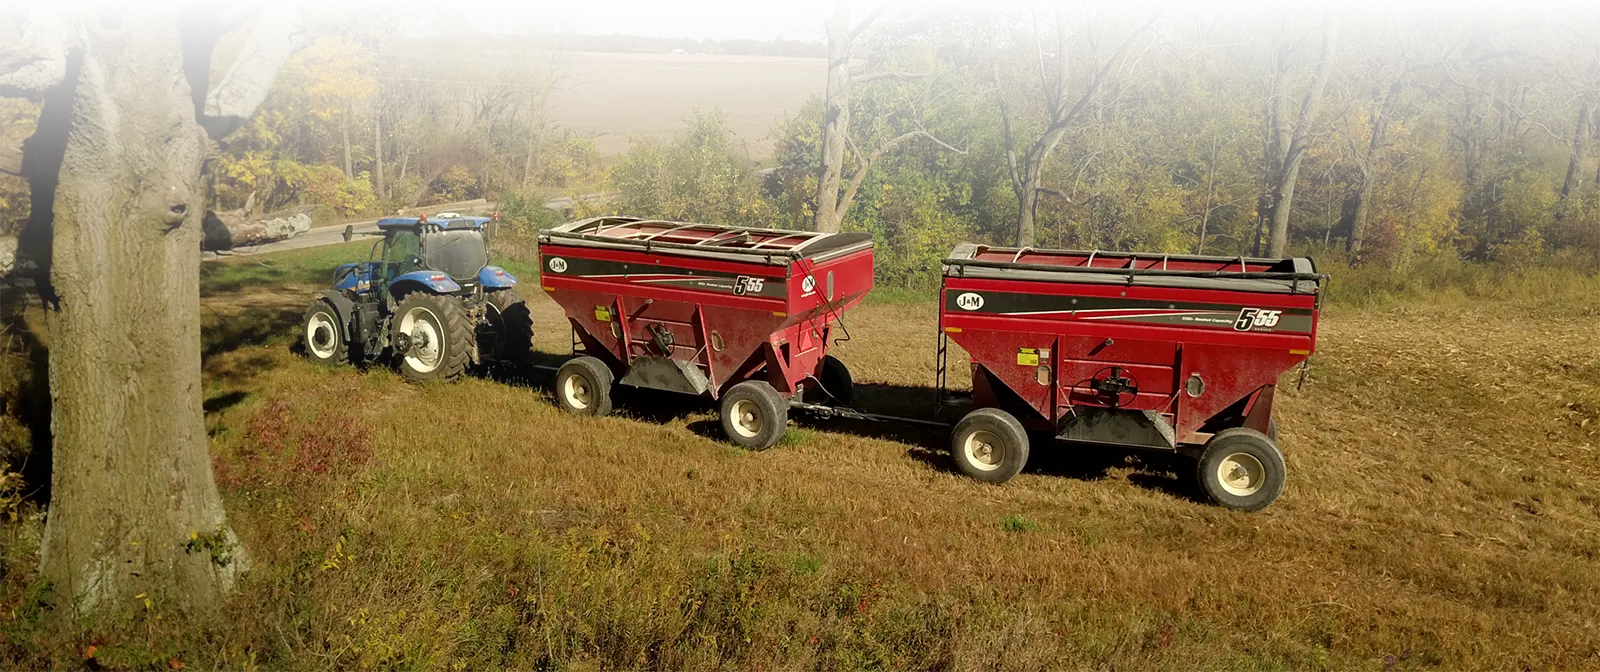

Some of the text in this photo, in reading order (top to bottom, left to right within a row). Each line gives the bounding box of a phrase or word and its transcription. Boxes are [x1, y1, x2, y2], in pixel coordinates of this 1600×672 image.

[550, 260, 565, 270] J&M
[733, 275, 765, 296] 555
[959, 296, 980, 307] J&M
[1234, 307, 1282, 331] 555
